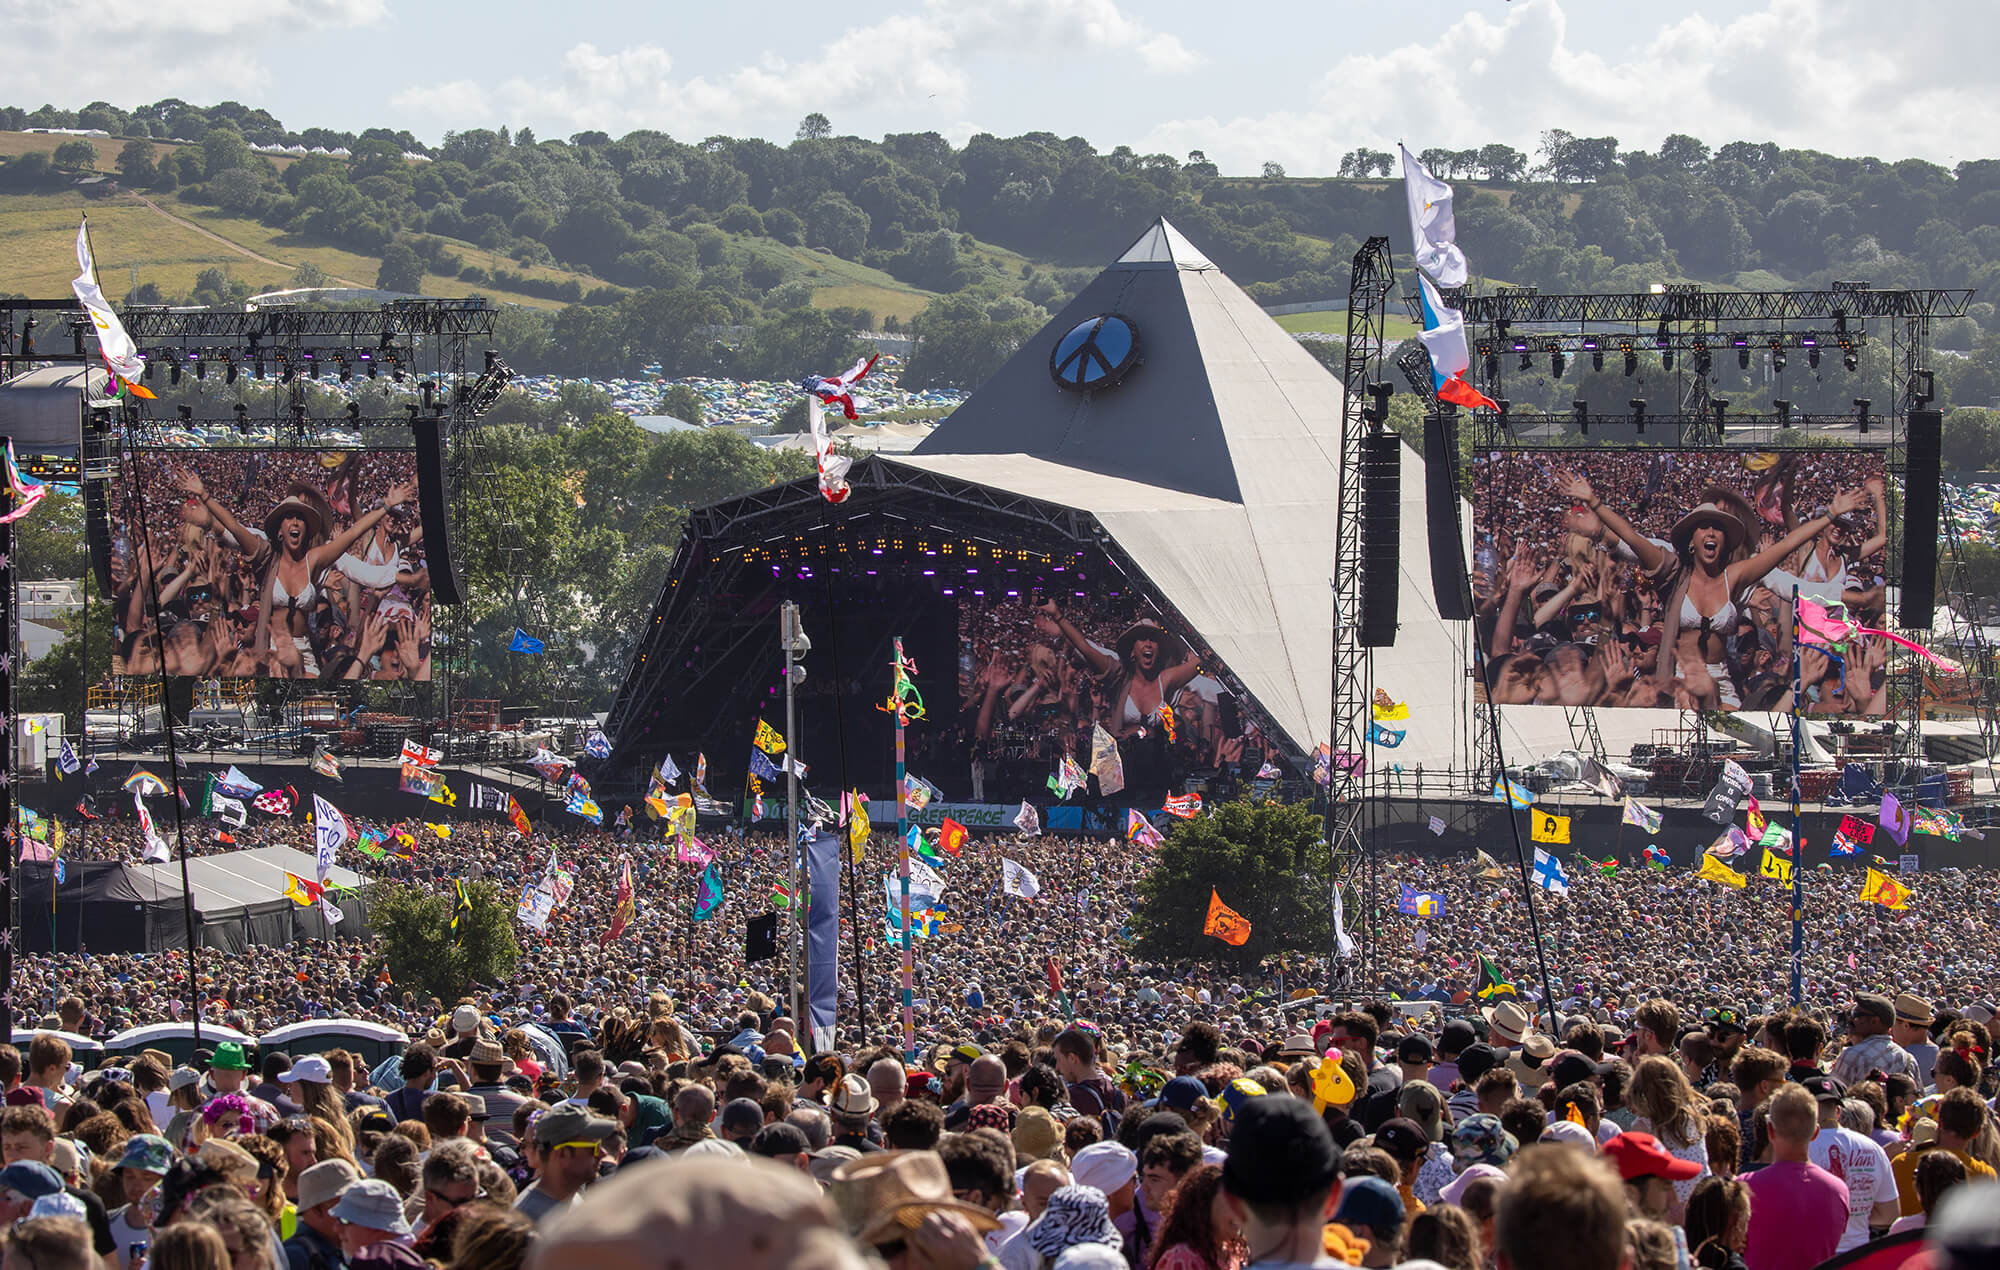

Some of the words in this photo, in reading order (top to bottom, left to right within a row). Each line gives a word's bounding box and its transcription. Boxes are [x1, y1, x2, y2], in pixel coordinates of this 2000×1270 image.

[908, 807, 1006, 825] GREENPEACE
[318, 825, 341, 848] TO
[1848, 1149, 1876, 1167] Vans
